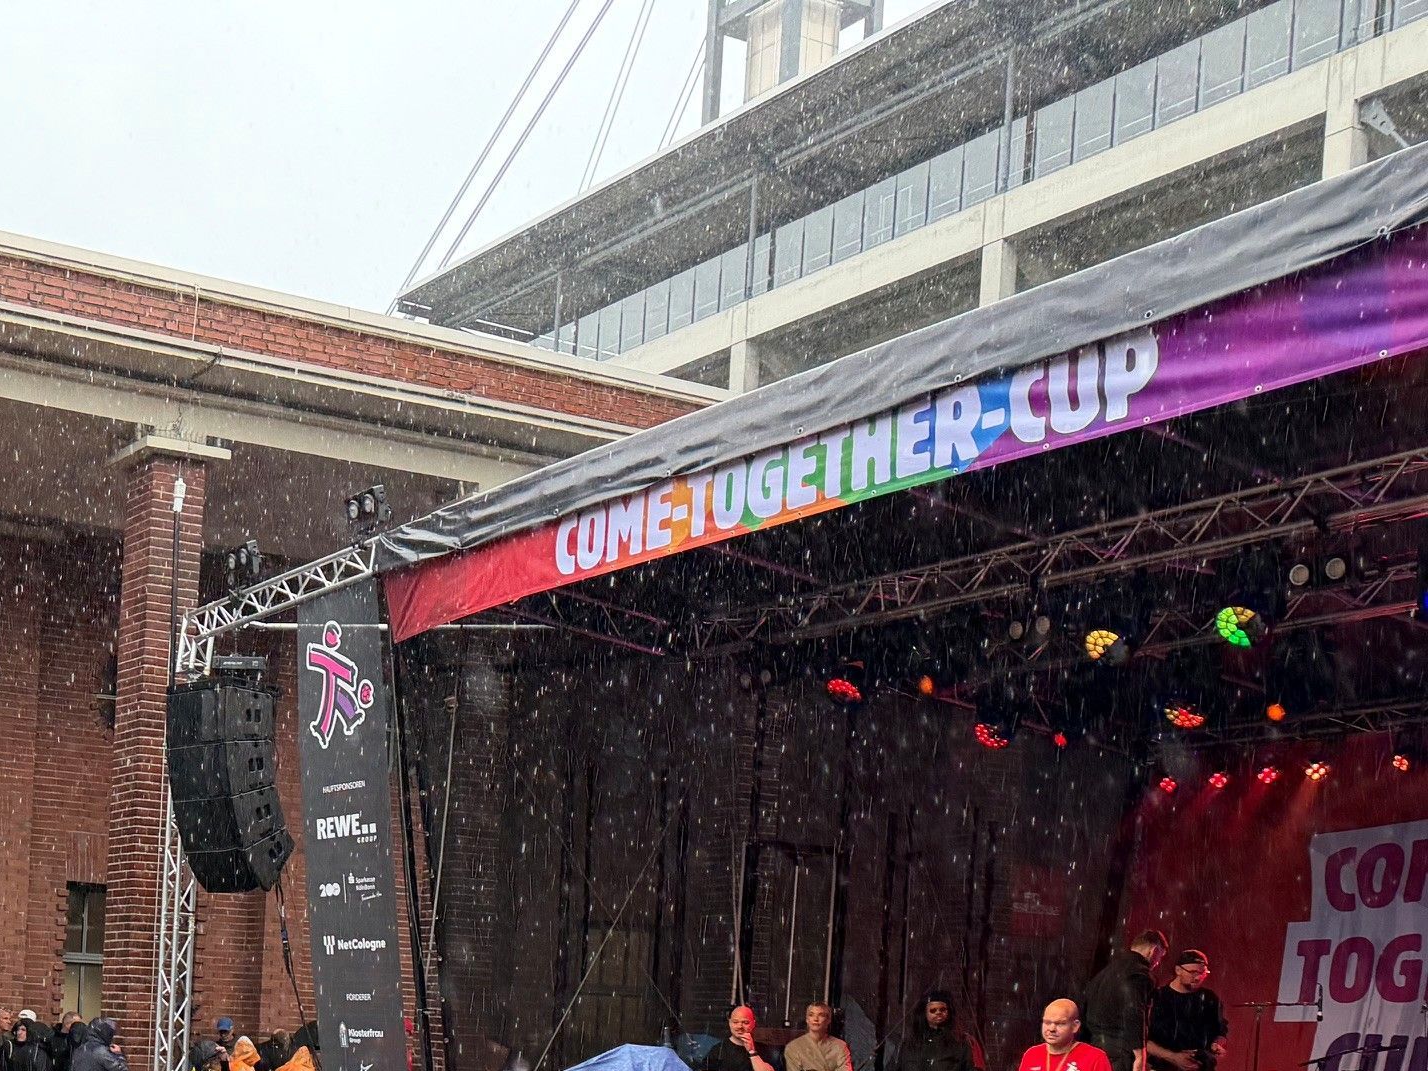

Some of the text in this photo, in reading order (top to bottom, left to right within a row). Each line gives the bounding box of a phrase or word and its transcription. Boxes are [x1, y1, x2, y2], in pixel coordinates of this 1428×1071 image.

[555, 330, 1160, 575] COME-TOGETHER-CUP
[322, 780, 366, 794] HAUPTSPONSOREN
[337, 937, 387, 951] NetCologne
[1297, 934, 1428, 1004] TOG
